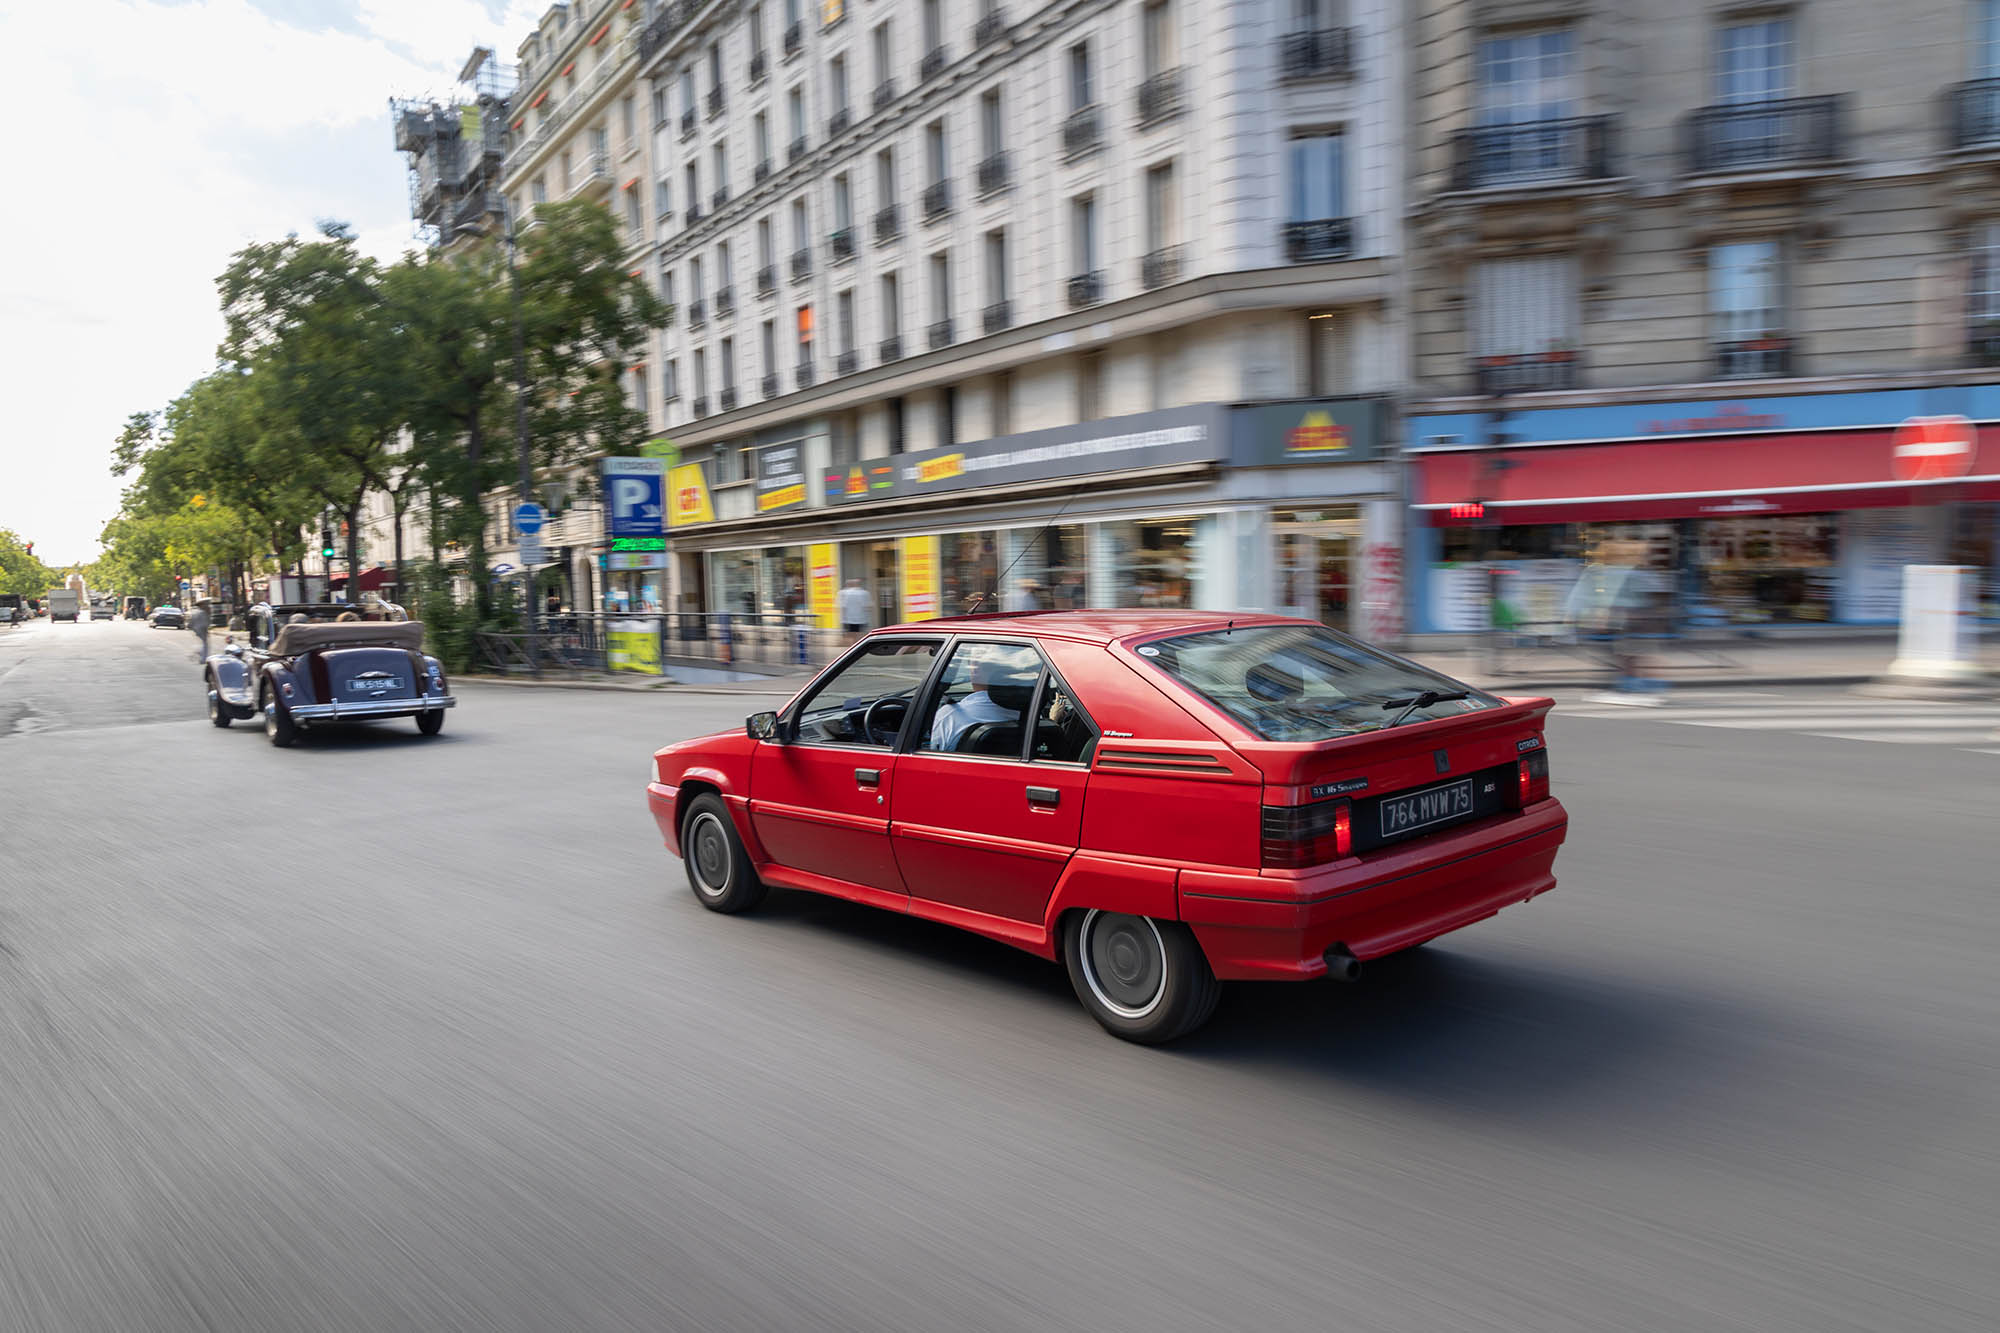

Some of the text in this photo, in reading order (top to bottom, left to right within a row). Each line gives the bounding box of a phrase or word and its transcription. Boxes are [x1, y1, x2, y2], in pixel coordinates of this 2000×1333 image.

[612, 479, 650, 518] P
[1387, 785, 1469, 829] 764 MVW 75
